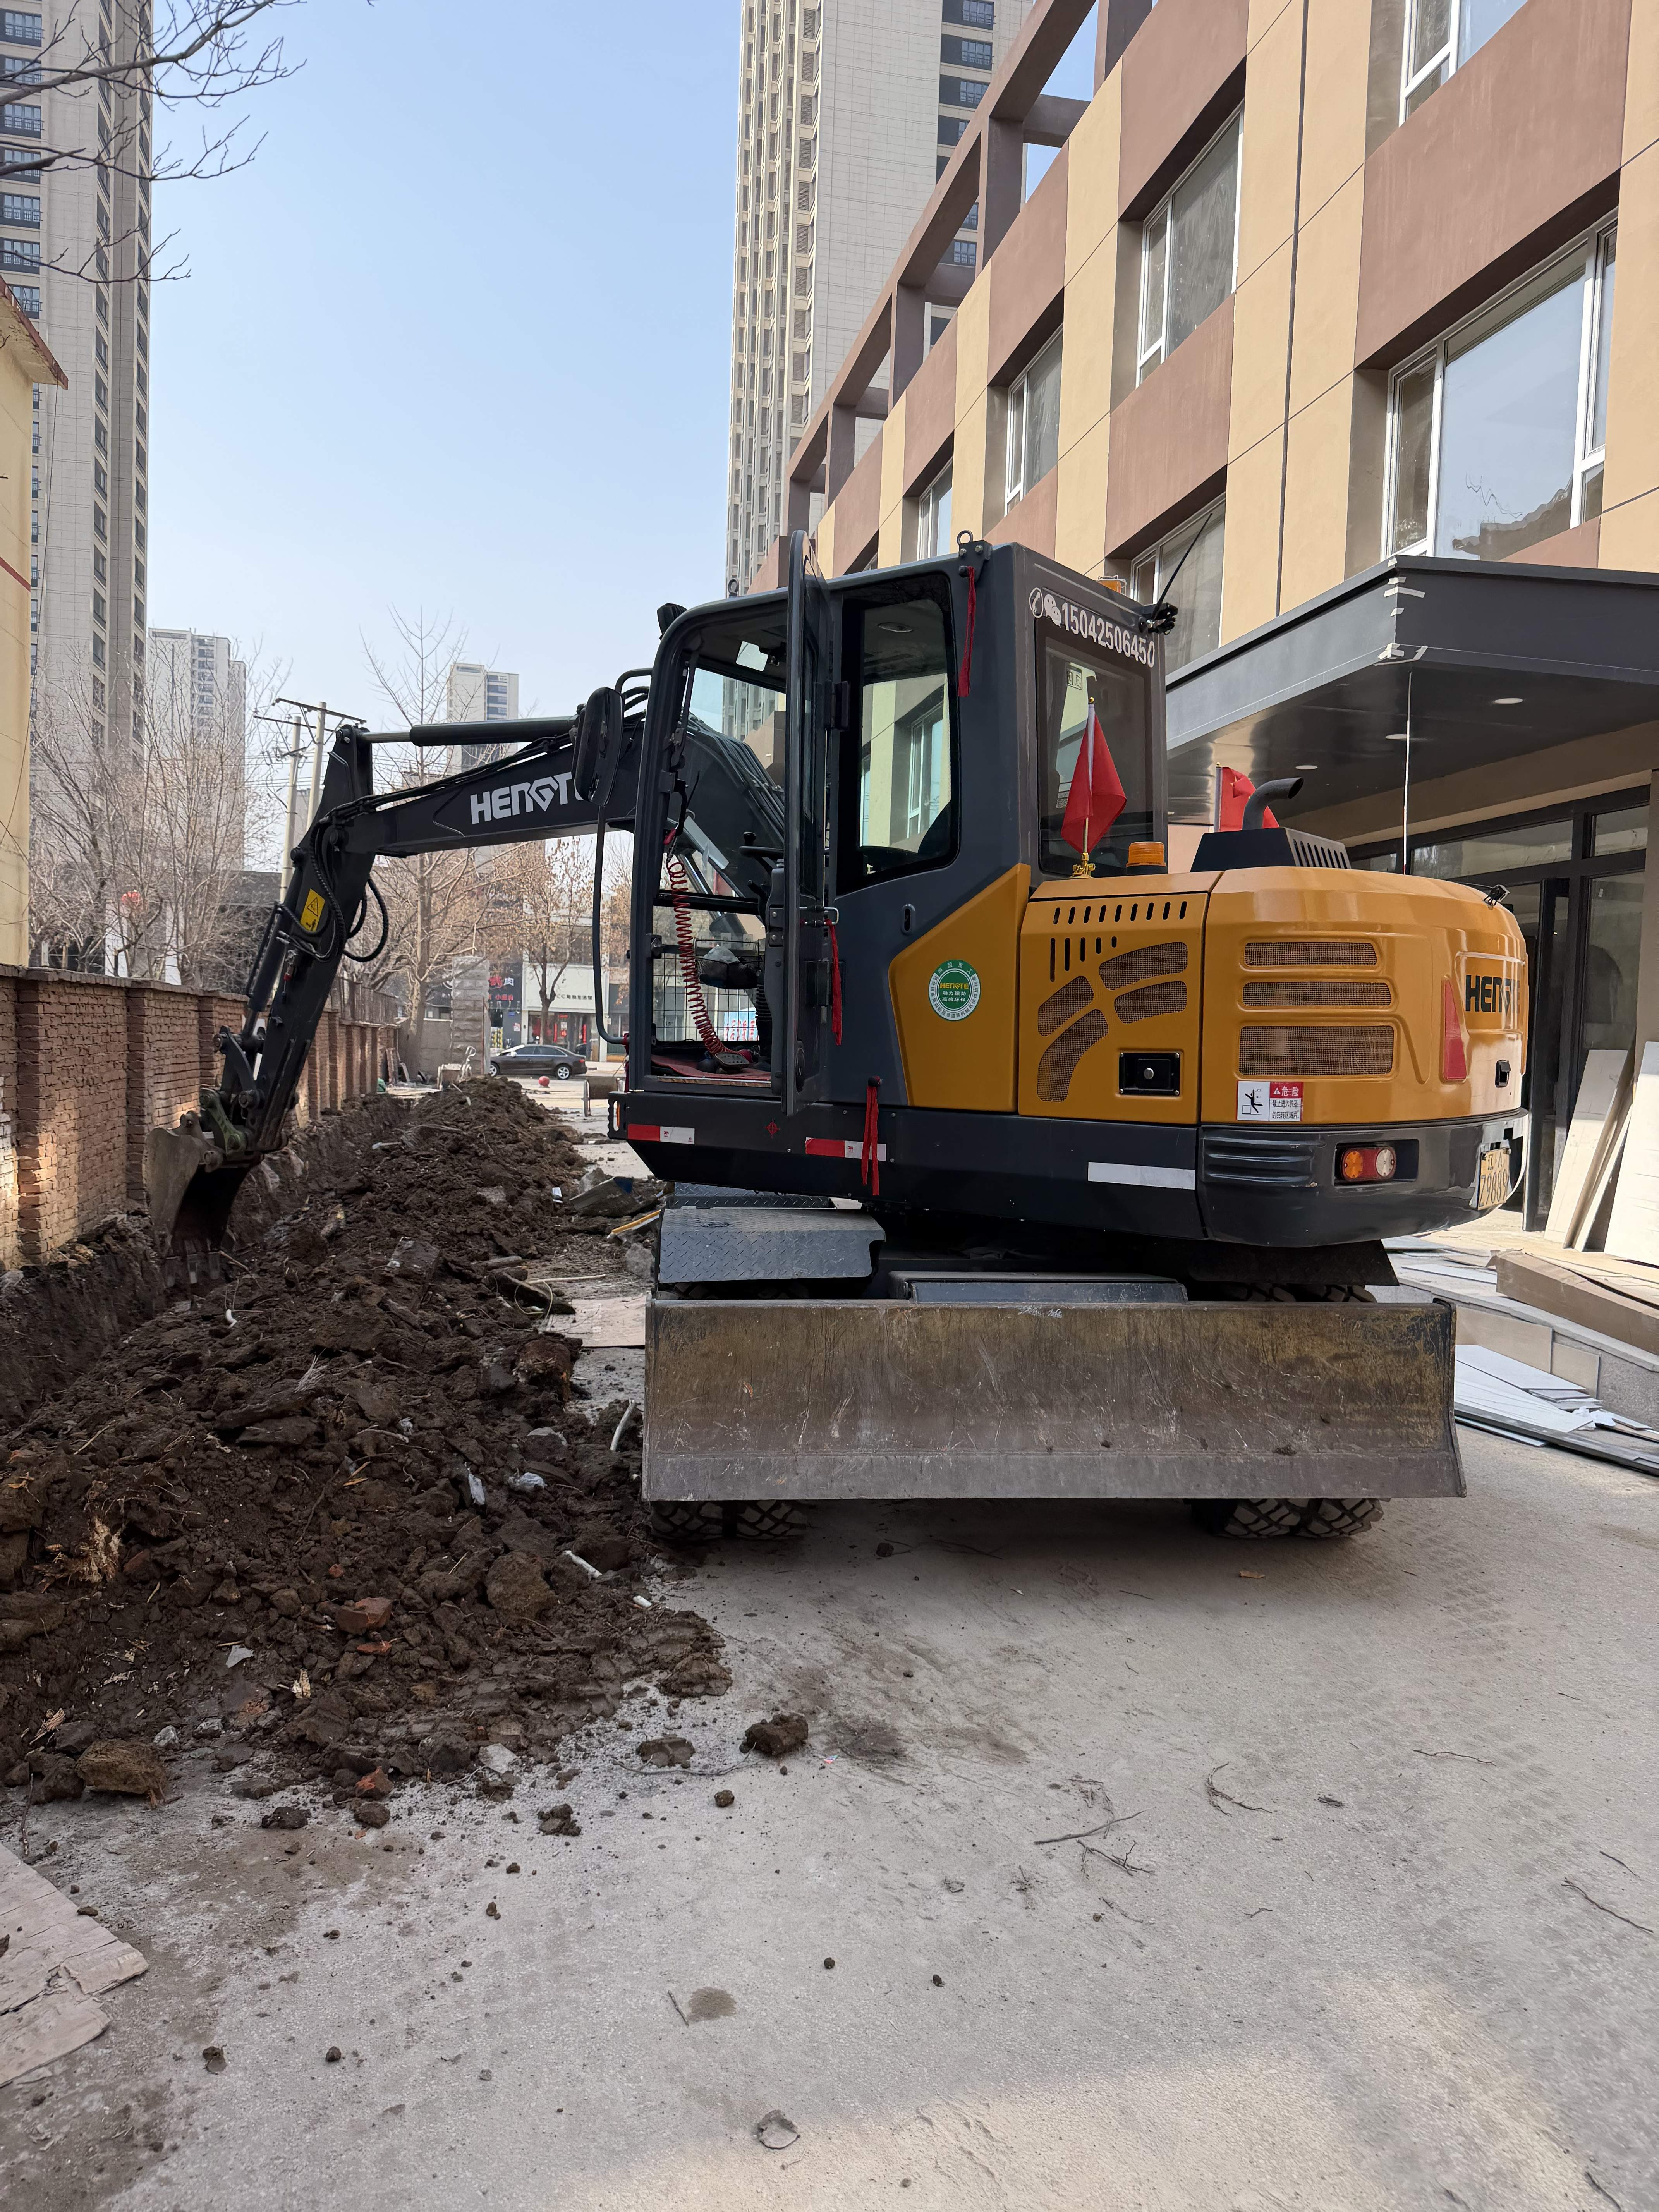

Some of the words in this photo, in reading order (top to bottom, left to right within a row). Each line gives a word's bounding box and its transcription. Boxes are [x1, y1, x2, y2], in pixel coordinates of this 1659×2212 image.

[1061, 602, 1155, 668] 15042506450
[470, 771, 584, 825] HENGT
[1281, 1085, 1299, 1097] 危险
